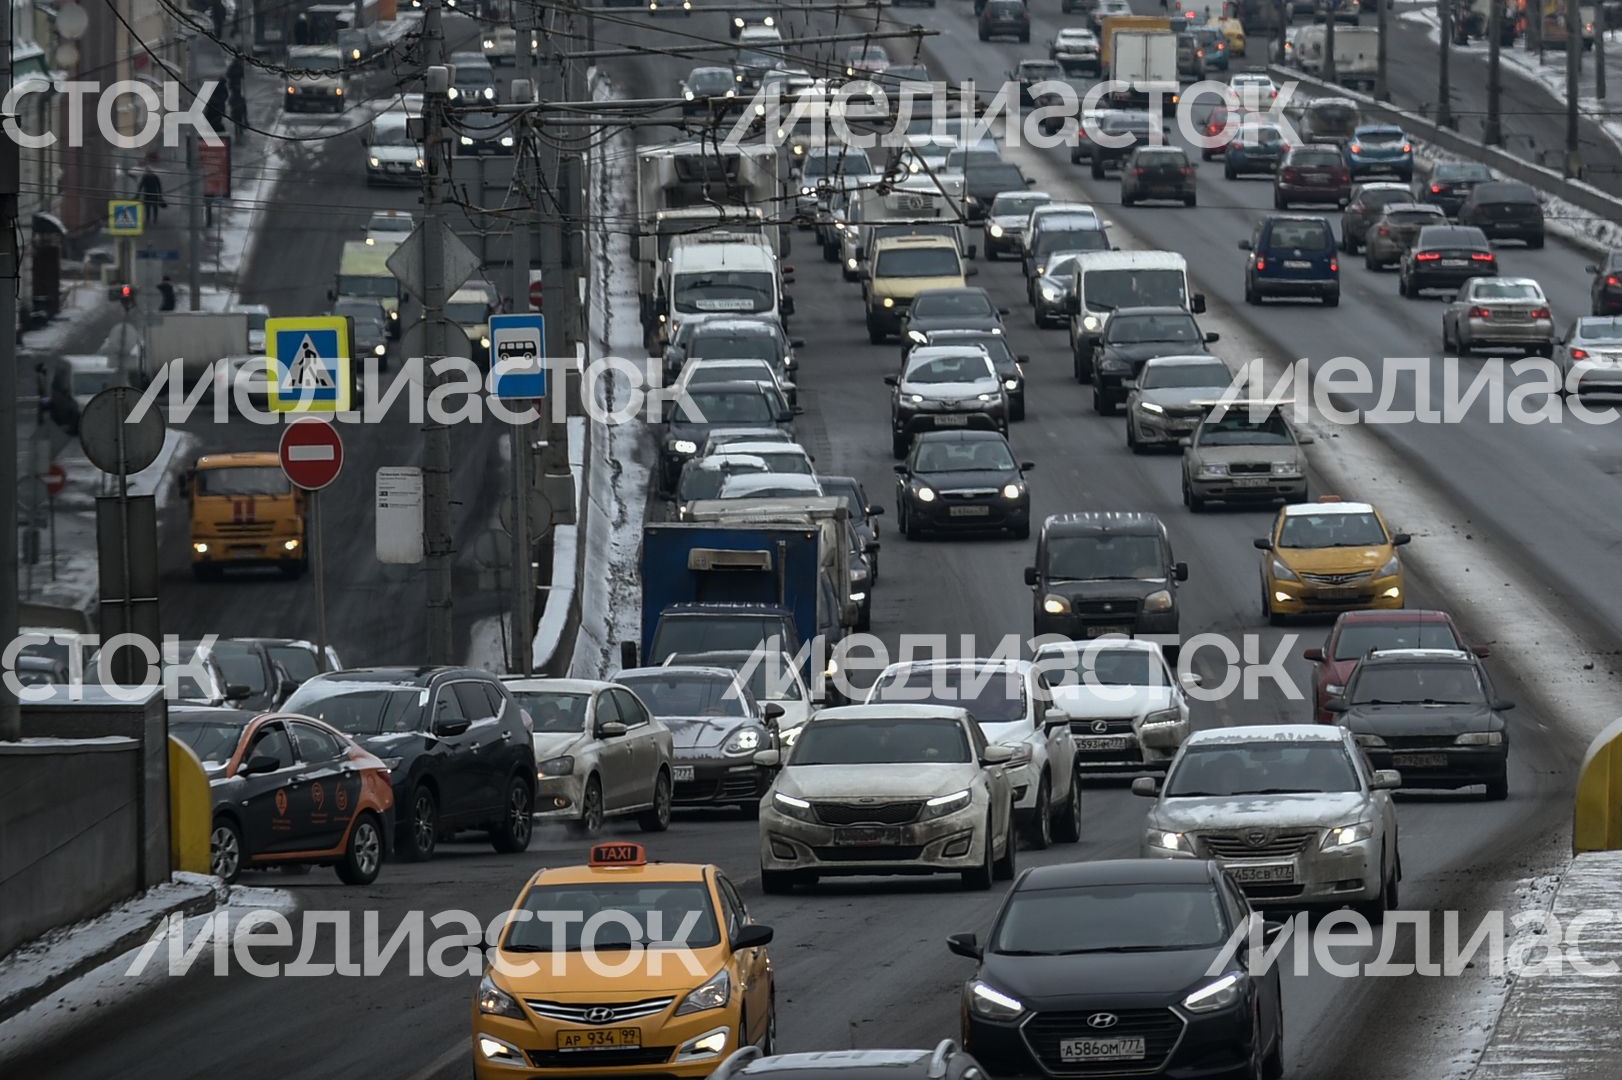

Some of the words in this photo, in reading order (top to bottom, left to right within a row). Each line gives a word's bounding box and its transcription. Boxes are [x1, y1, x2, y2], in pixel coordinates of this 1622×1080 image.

[600, 847, 631, 860] TAXI
[1233, 869, 1270, 880] 453СВ
[565, 1035, 581, 1046] АР
[587, 1032, 614, 1045] 934
[622, 1030, 635, 1039] 99
[1064, 1041, 1118, 1056] А586ОМ
[1121, 1040, 1140, 1050] 777
